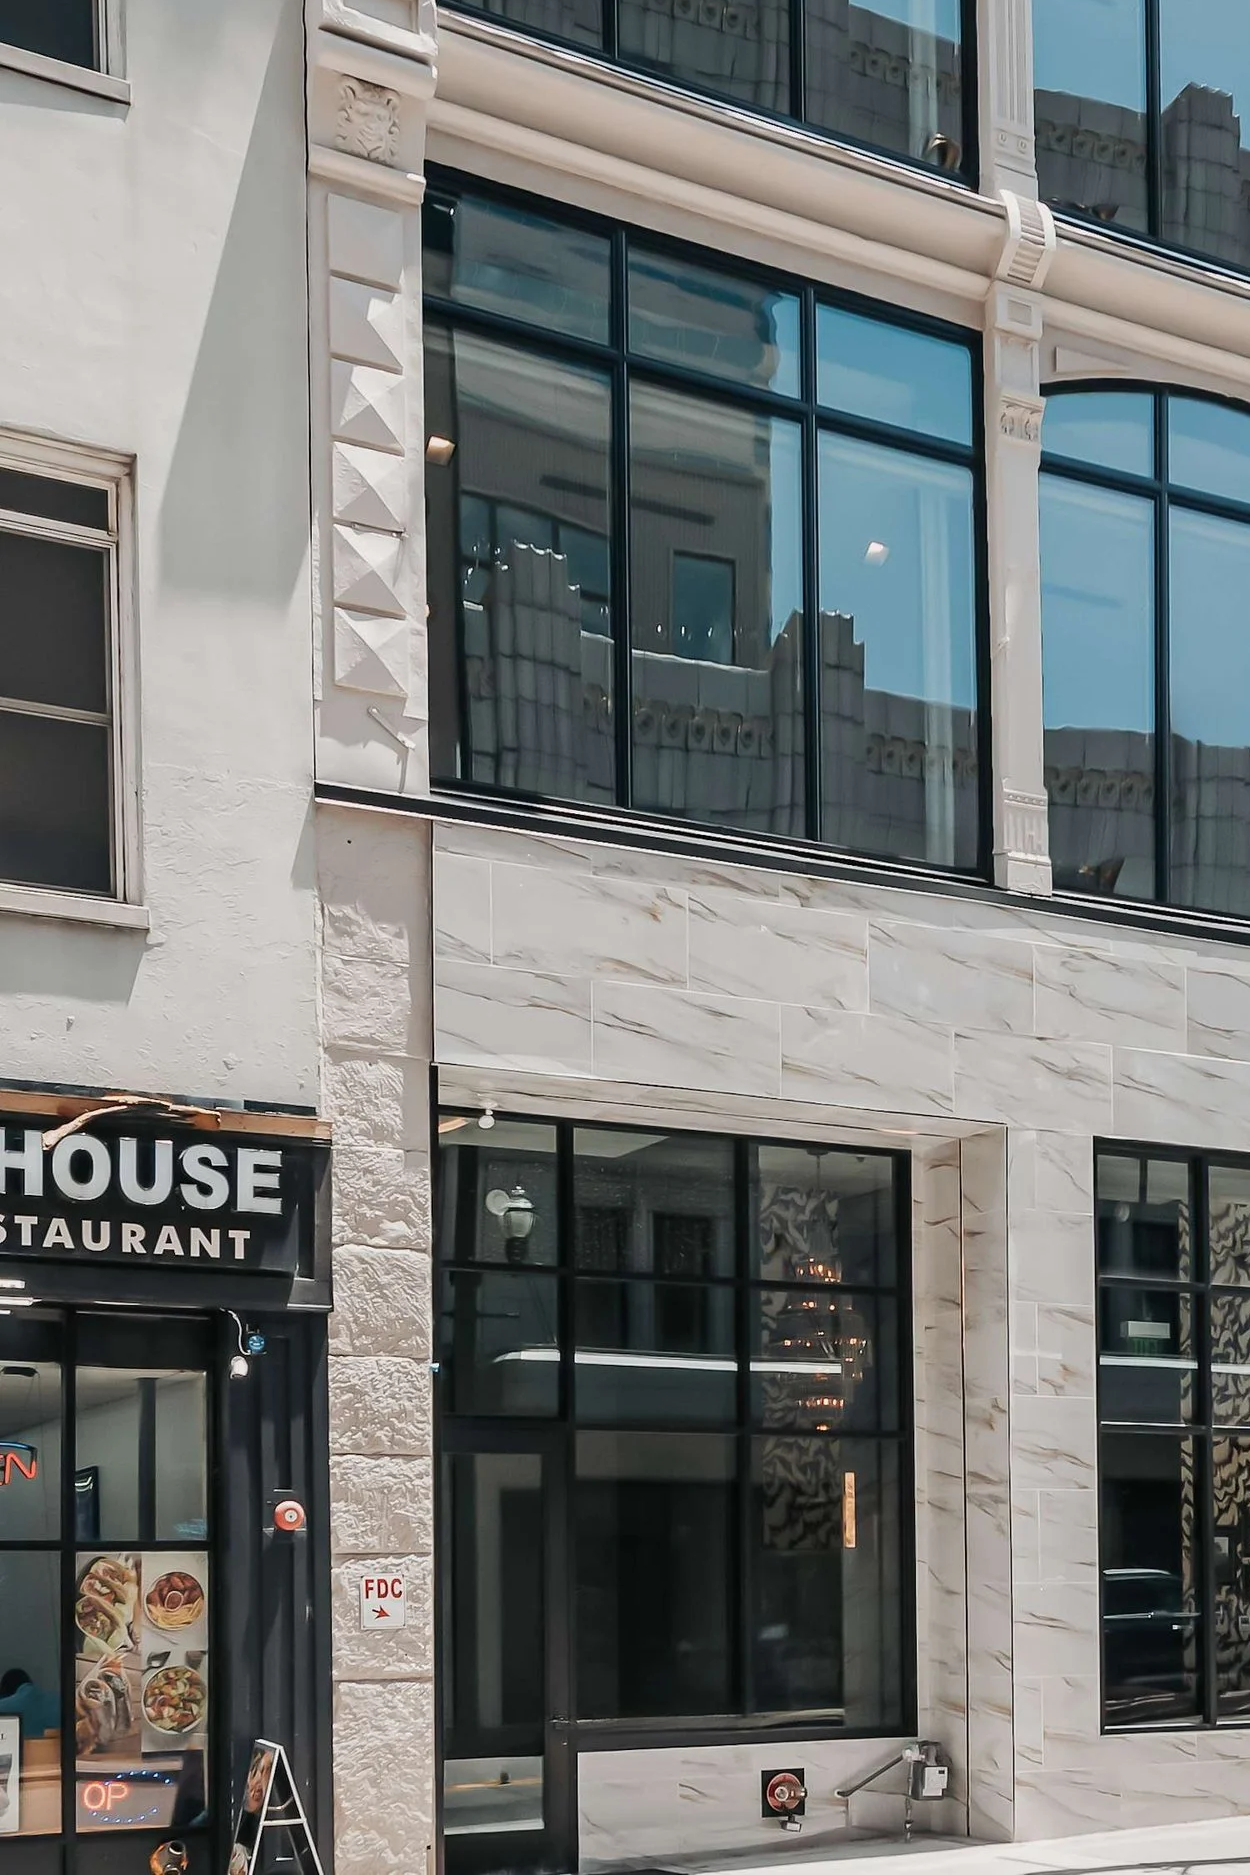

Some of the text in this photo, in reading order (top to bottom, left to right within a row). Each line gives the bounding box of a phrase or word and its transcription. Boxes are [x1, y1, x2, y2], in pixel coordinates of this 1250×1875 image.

[0, 1128, 282, 1214] HOUSE
[365, 1578, 403, 1599] FDC
[83, 1782, 129, 1810] OP
